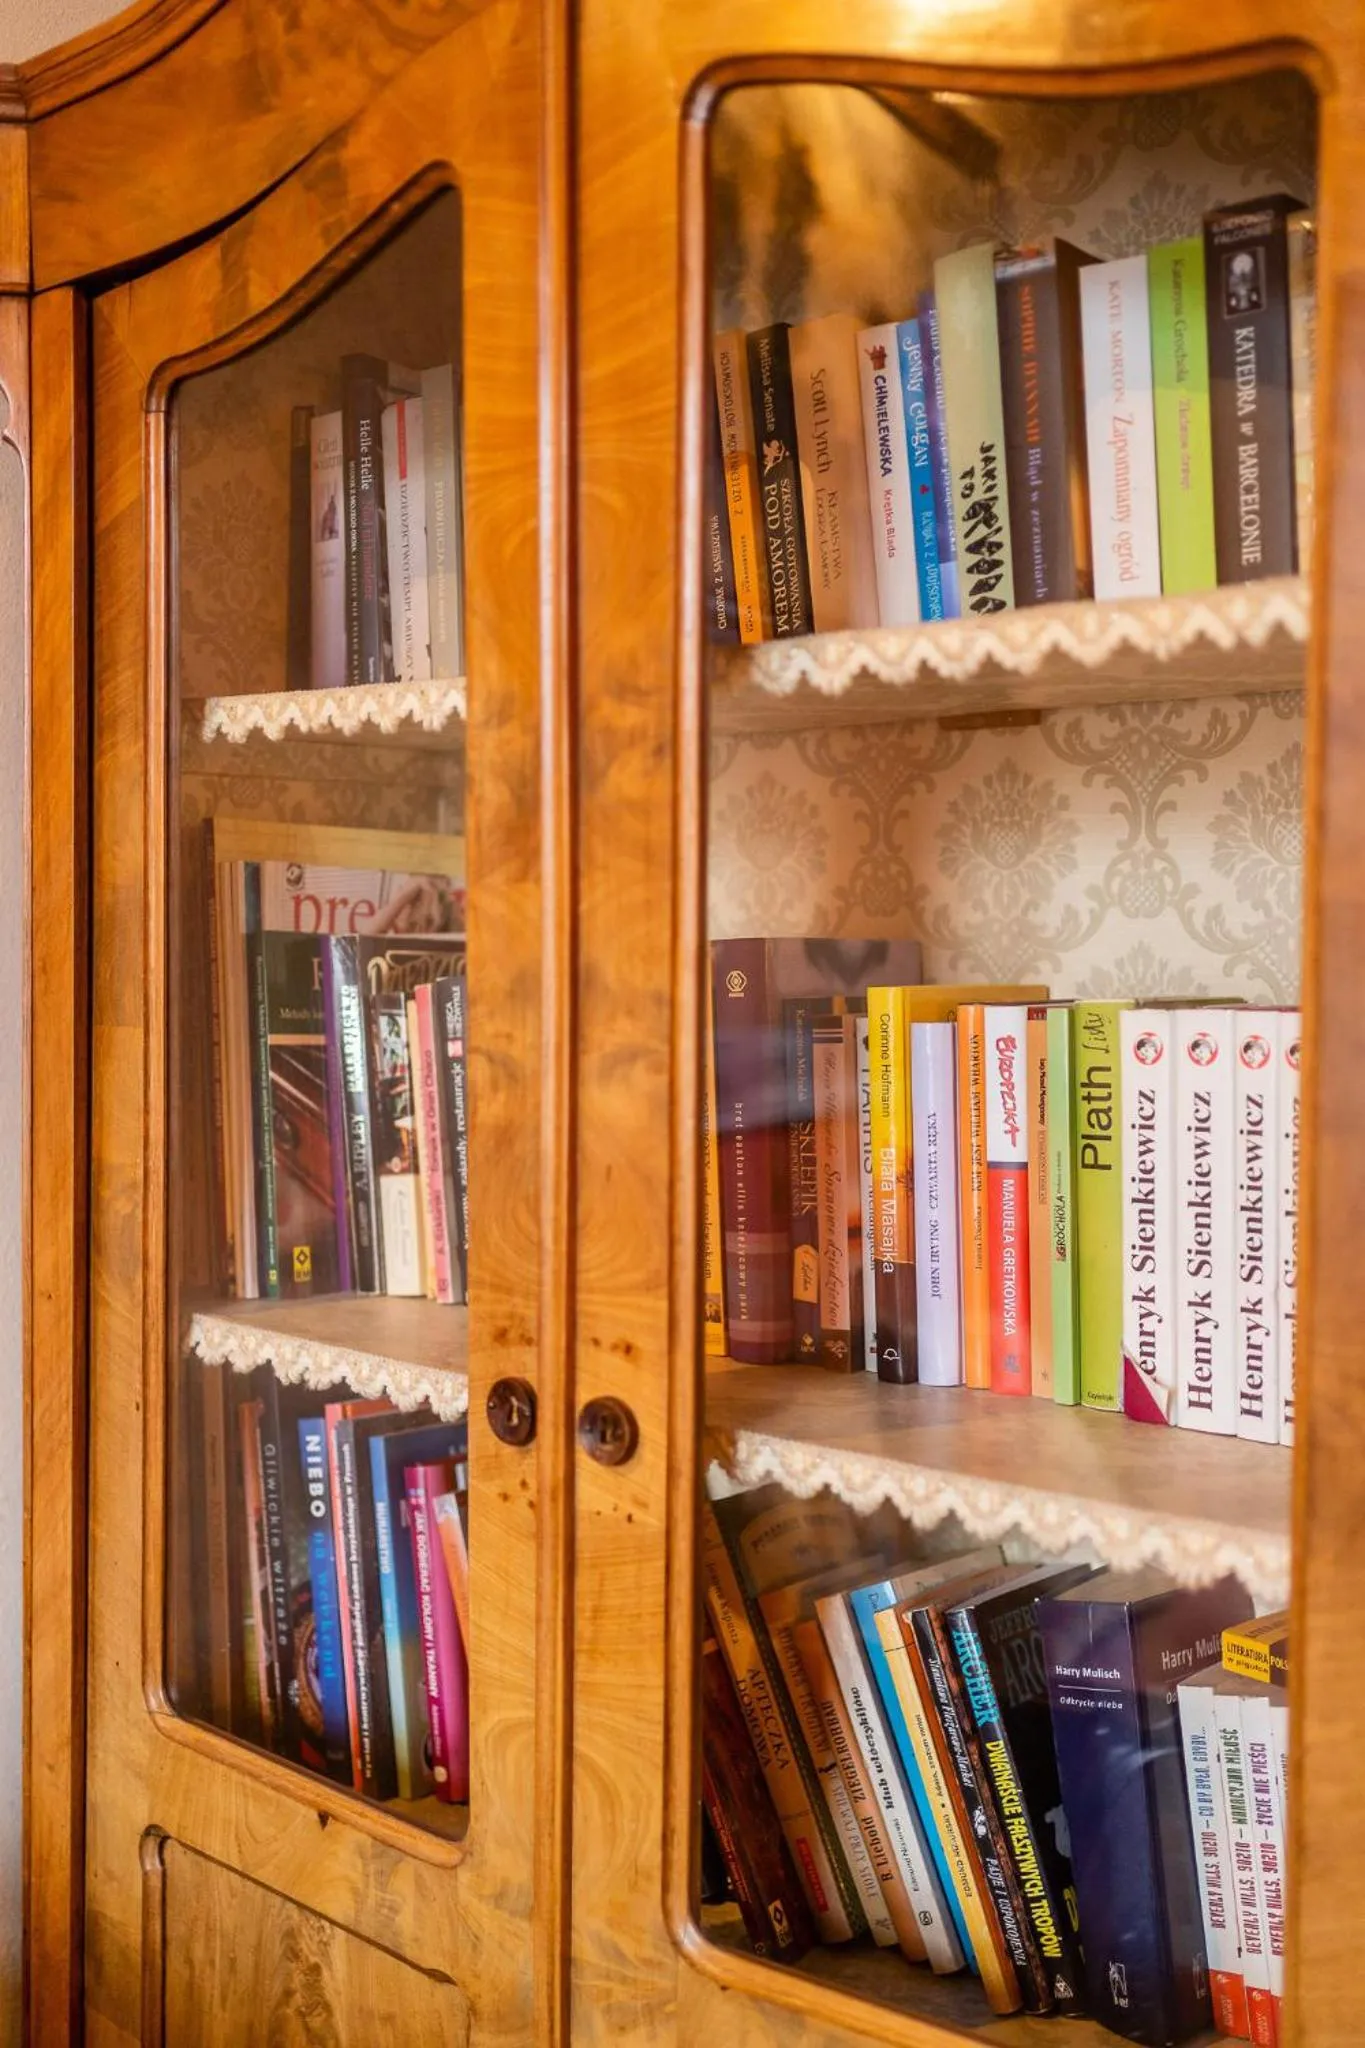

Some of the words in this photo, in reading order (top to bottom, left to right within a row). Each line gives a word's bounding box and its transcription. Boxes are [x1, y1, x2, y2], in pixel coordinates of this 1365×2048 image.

[1108, 279, 1122, 321] KATE
[759, 337, 773, 385] Melissa
[1110, 330, 1125, 402] MORTON
[1174, 319, 1188, 383] Grochola
[1233, 325, 1257, 417] KATEDRA
[763, 387, 776, 432] Senate
[810, 367, 827, 416] Scott
[360, 419, 371, 453] Helle
[812, 418, 834, 474] Lynch
[1242, 421, 1254, 435] w
[361, 456, 372, 490] Helle
[1107, 411, 1134, 527] Zapomniany
[764, 484, 780, 529] POD
[780, 477, 793, 534] SZKOŁA
[1237, 442, 1262, 566] BARCELONIE
[886, 526, 896, 559] Blada
[1030, 506, 1046, 599] zeznaniach
[1110, 531, 1139, 583] ogród
[769, 537, 789, 633] AMOREM
[785, 536, 801, 629] GOTOWANIA
[878, 1013, 890, 1059] Corinne
[969, 1033, 979, 1086] WHARTON
[427, 1049, 437, 1087] Chaco
[879, 1062, 891, 1118] Hofmann
[447, 1061, 465, 1130] restauracje
[735, 1102, 744, 1128] bret
[970, 1091, 980, 1138] WILLIAM
[1082, 1065, 1112, 1171] Plath
[353, 1113, 367, 1170] RIPLEY
[430, 1134, 441, 1173] Tomek
[929, 1113, 941, 1147] RĘKA
[736, 1134, 745, 1175] easton
[800, 1121, 818, 1215] SKLEPIK
[880, 1147, 895, 1190] Biała
[971, 1144, 981, 1168] JEST
[737, 1182, 746, 1210] ellis
[929, 1151, 940, 1210] CZWARTA
[1130, 1088, 1157, 1274] Sienkiewicz
[1186, 1090, 1213, 1280] Sienkiewicz
[1239, 1093, 1265, 1286] Sienkiewicz
[433, 1189, 443, 1240] Szklarski
[881, 1194, 900, 1274] Masajka
[1002, 1178, 1015, 1246] MANUELA
[929, 1218, 941, 1263] IRVING
[930, 1266, 942, 1299] JOHN
[1003, 1247, 1016, 1336] GRETKOWSKA
[1130, 1283, 1163, 1382] enryk
[1187, 1289, 1220, 1412] Henryk
[1240, 1293, 1271, 1420] Henryk
[305, 1433, 326, 1518] NIEBO
[264, 1443, 280, 1547] Gliwickie
[273, 1561, 289, 1646] witraże
[313, 1531, 325, 1560] na
[316, 1569, 337, 1680] weekend
[717, 1597, 739, 1645] Kapusta
[425, 1648, 440, 1698] TKANINY
[1054, 1664, 1080, 1678] Harry
[1082, 1666, 1121, 1680] Mulisch
[1161, 1647, 1194, 1671] Harry
[1226, 1642, 1269, 1665] LITERATURA
[952, 1630, 998, 1727] ARCHER
[735, 1678, 774, 1769] DOMOWA
[746, 1667, 790, 1770] APTECZKA
[1060, 1696, 1096, 1709] Odkrycie
[1098, 1699, 1124, 1710] nieba
[851, 1686, 885, 1777] włóczykijów
[1219, 1727, 1240, 1766] MIŁOŚĆ
[1250, 1742, 1268, 1774] PIEŚCI
[879, 1779, 895, 1810] klub
[1225, 1767, 1248, 1826] WAKACYJNA
[1254, 1776, 1271, 1795] NIE
[1255, 1795, 1275, 1827] ŻYCIE
[861, 1816, 889, 1870] Liebold
[985, 1740, 1023, 1816] DWANAŚCIE
[1006, 1814, 1046, 1898] FAŁSZYWYCH
[1031, 1896, 1063, 1959] TROPÓW
[1201, 1831, 1217, 1859] 90210
[1234, 1841, 1253, 1873] 90210
[1260, 1842, 1278, 1875] 90210
[881, 1871, 894, 1882] B.
[953, 1859, 972, 1897] EDMUND
[1205, 1861, 1221, 1887] HILLS,
[1239, 1876, 1257, 1909] HILLS,
[1265, 1877, 1282, 1910] HILLS,
[1209, 1888, 1226, 1930] BEVERLY
[1242, 1911, 1263, 1956] BEVERLY
[1269, 1910, 1287, 1958] BEVERLY
